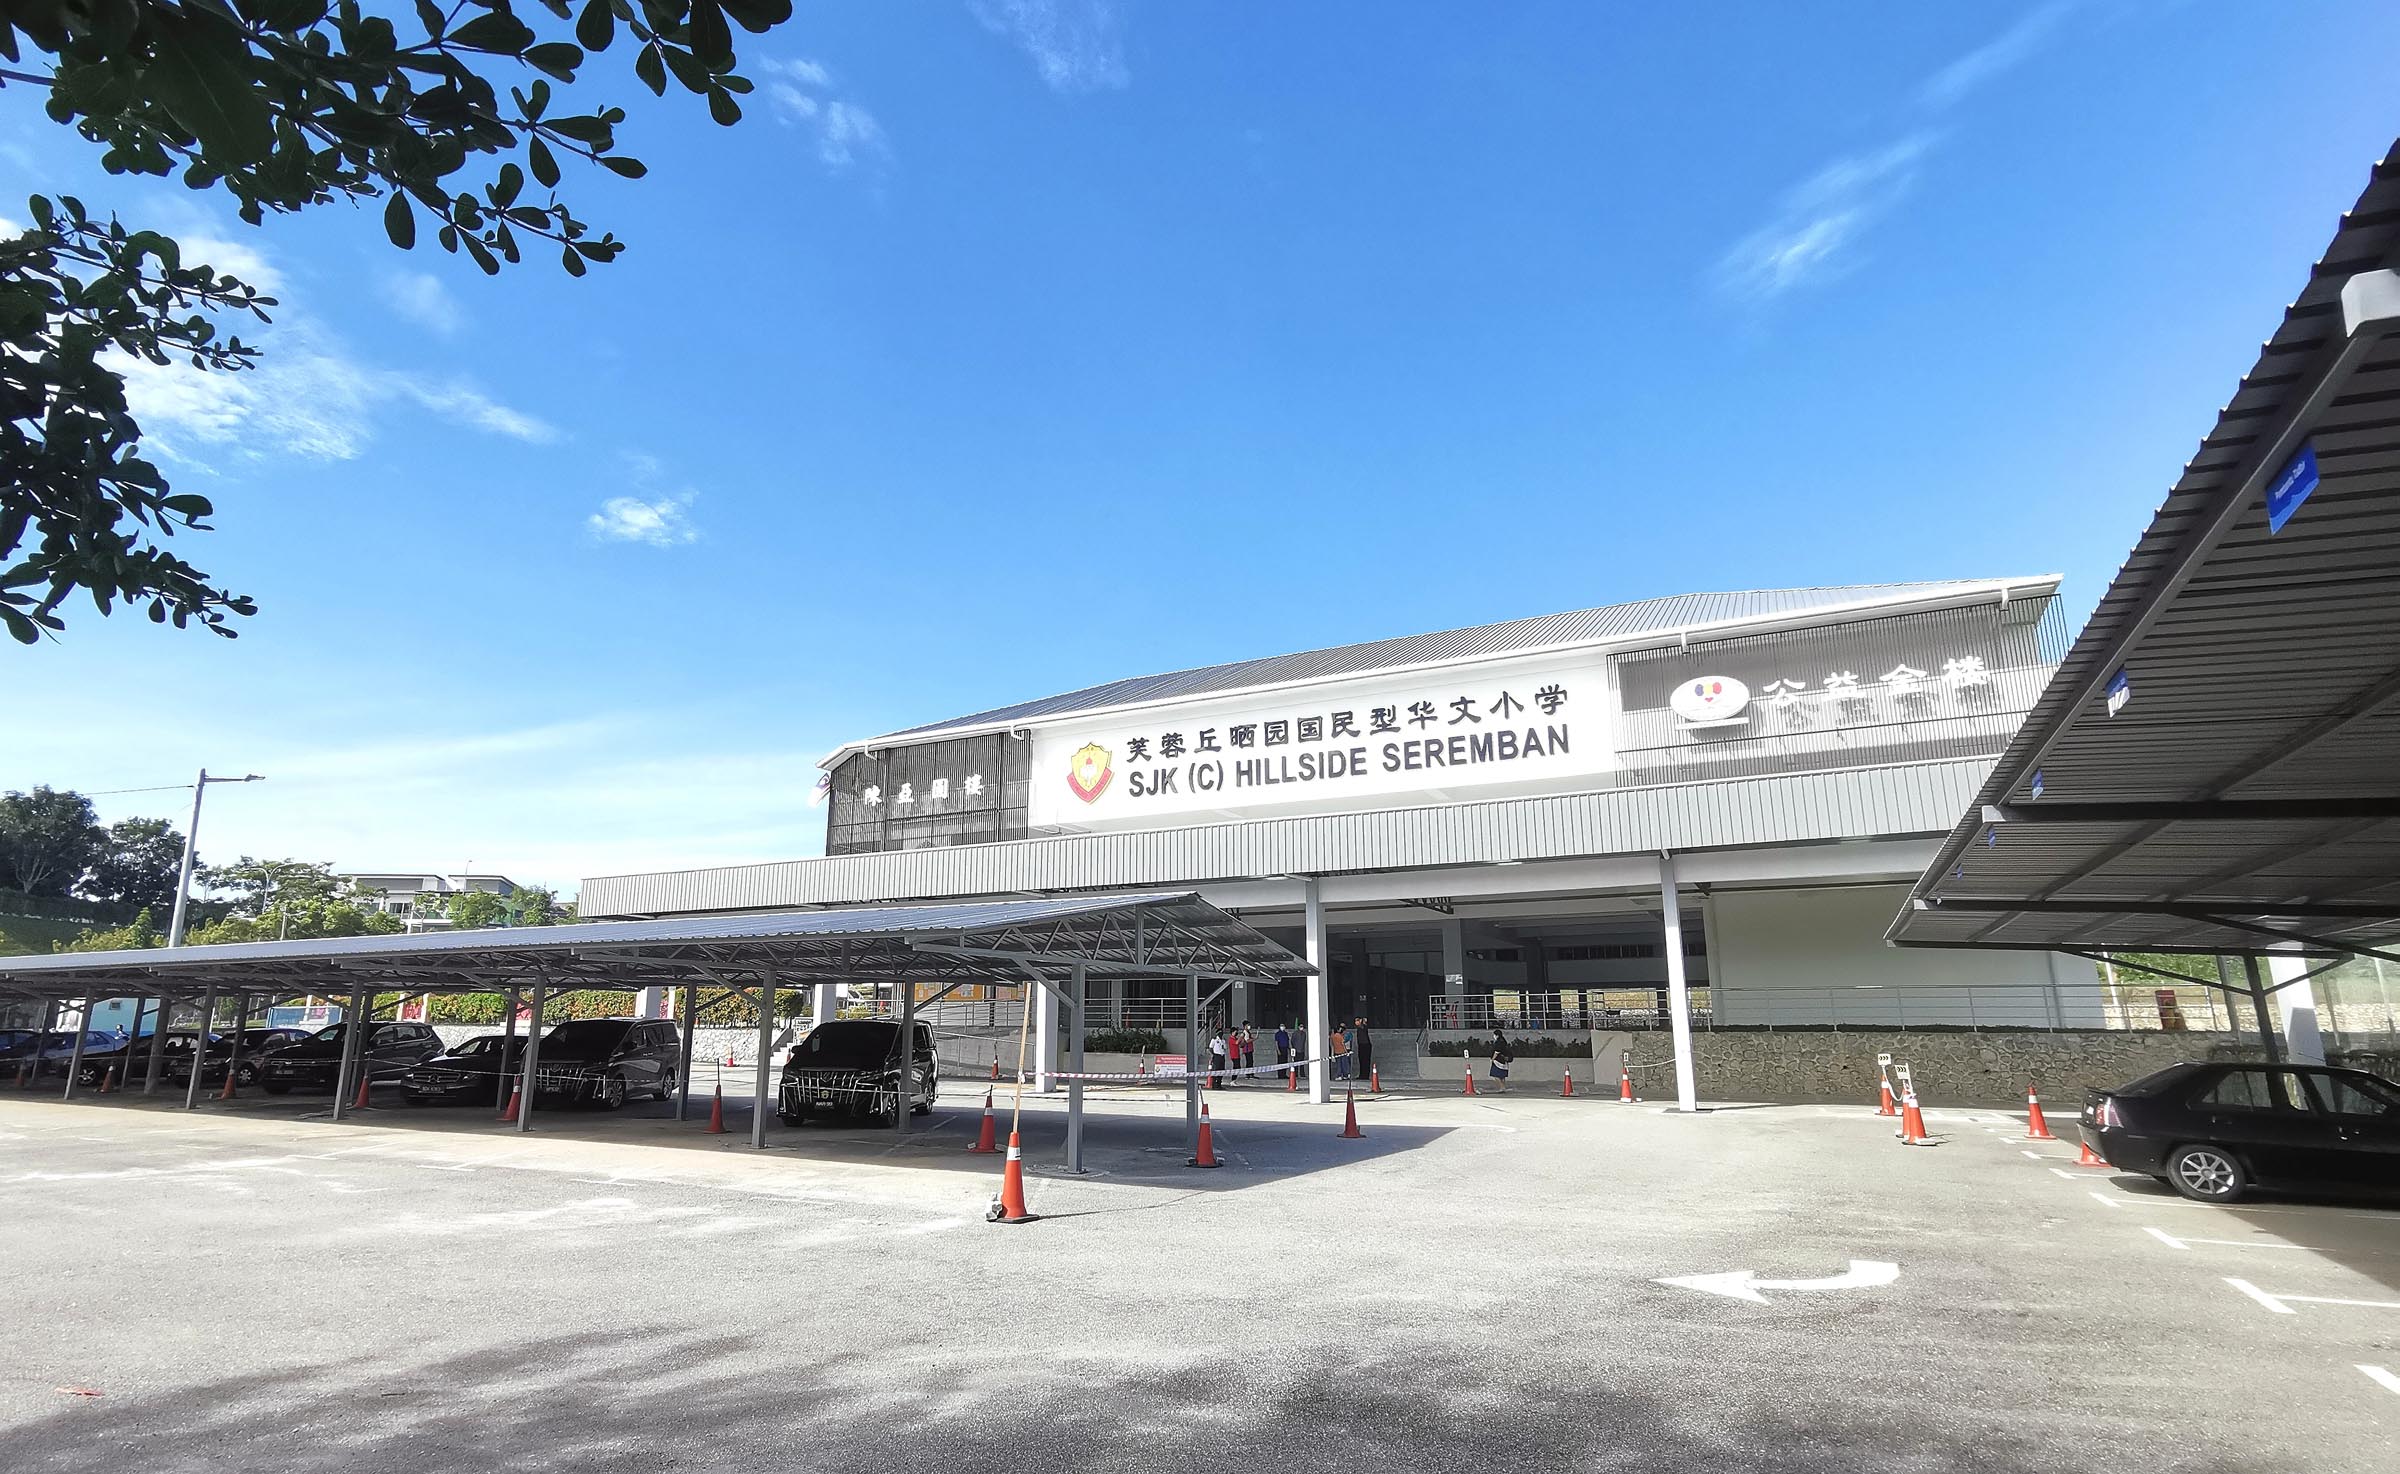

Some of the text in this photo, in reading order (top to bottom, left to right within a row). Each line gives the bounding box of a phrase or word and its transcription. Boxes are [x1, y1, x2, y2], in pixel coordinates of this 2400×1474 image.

[1126, 683, 1568, 763] 芙蓉丘晒园国民型华文小学
[1129, 767, 1179, 797] SJK
[1188, 760, 1224, 793] (C)
[1236, 747, 1368, 787] HILLSIDE
[1382, 723, 1570, 772] SEREMBAN
